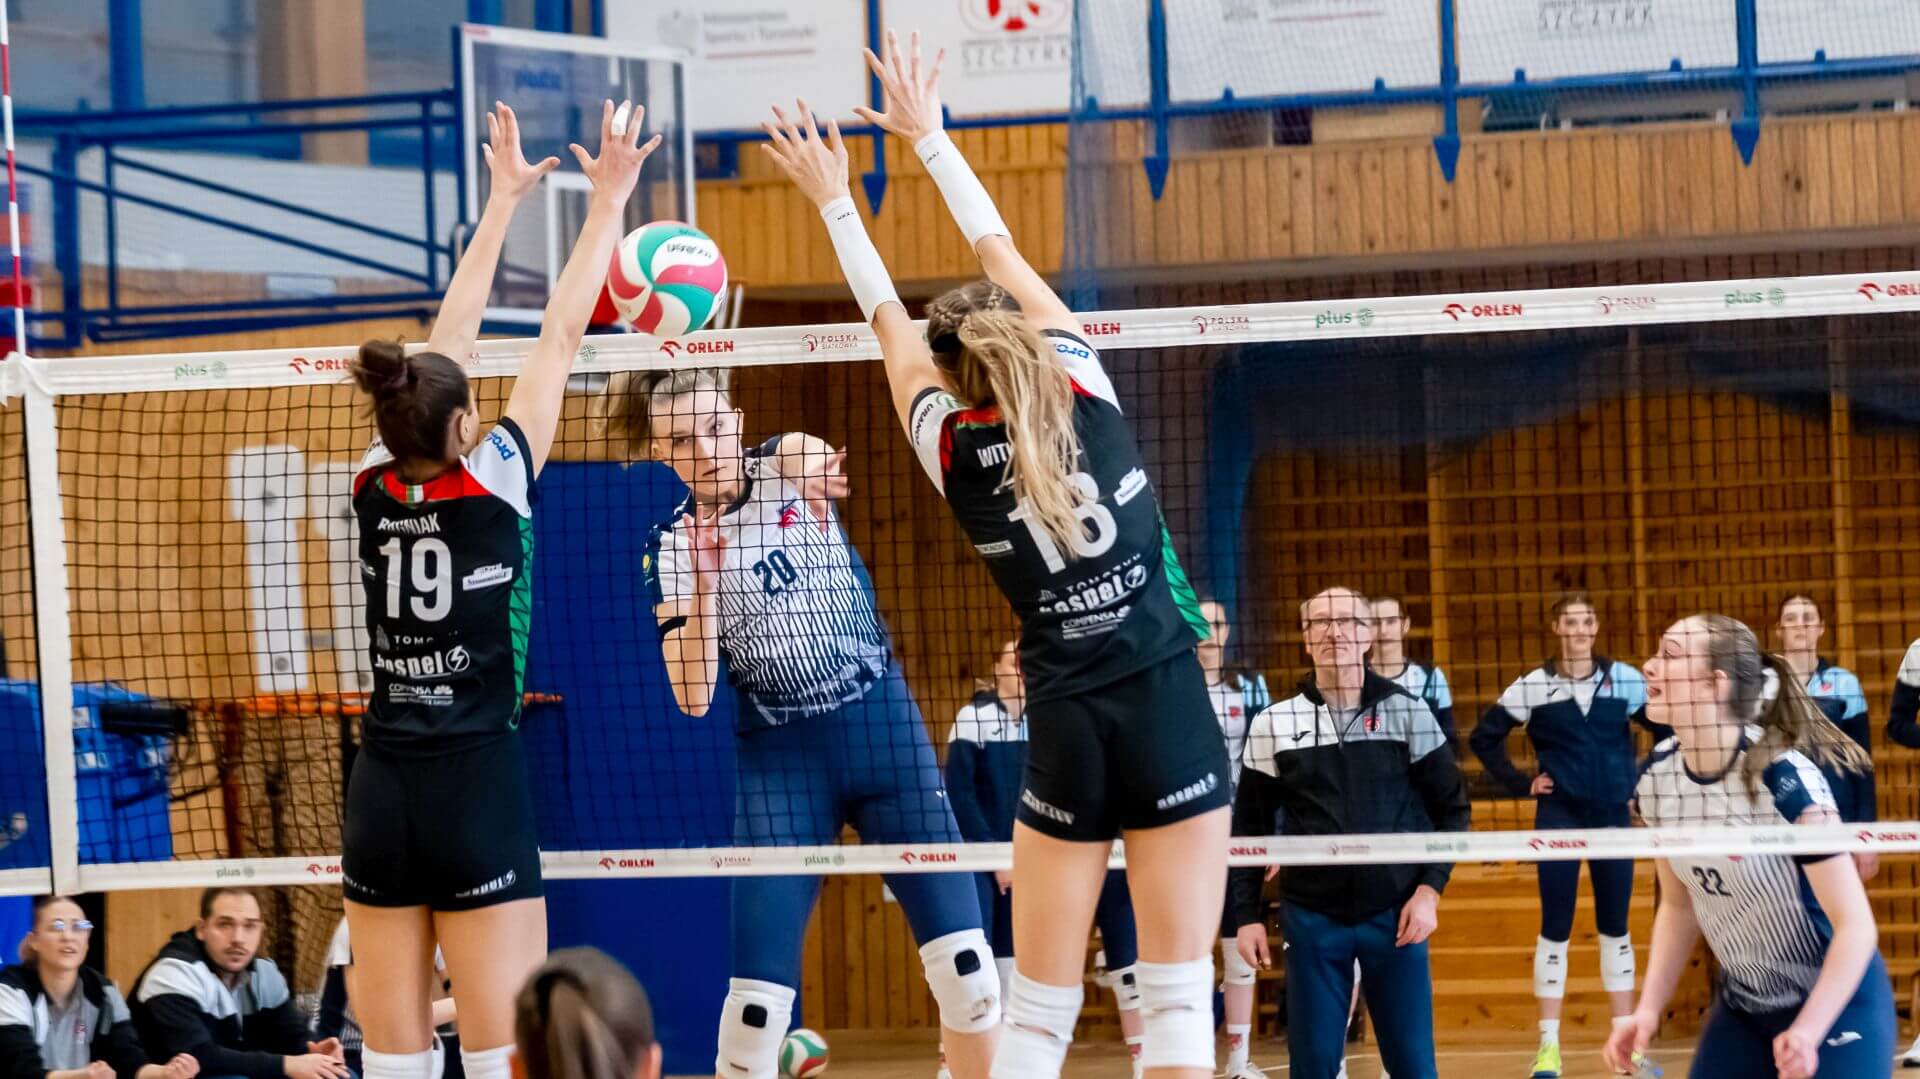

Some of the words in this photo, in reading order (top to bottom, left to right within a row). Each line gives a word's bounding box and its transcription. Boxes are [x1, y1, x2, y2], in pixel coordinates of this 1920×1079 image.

[1887, 283, 1920, 296] ORL
[1472, 303, 1522, 317] ORLEN
[1315, 310, 1352, 327] plus
[1084, 322, 1120, 336] RLEN
[821, 335, 858, 343] POLSKA
[687, 340, 734, 354] ORLEN
[175, 364, 207, 380] plus
[315, 359, 351, 372] ORLE
[378, 537, 452, 622] 19
[752, 550, 798, 597] 20
[619, 859, 655, 868] ORLEN
[804, 853, 830, 866] plus
[920, 853, 957, 863] ORLEN
[1692, 866, 1733, 897] 22
